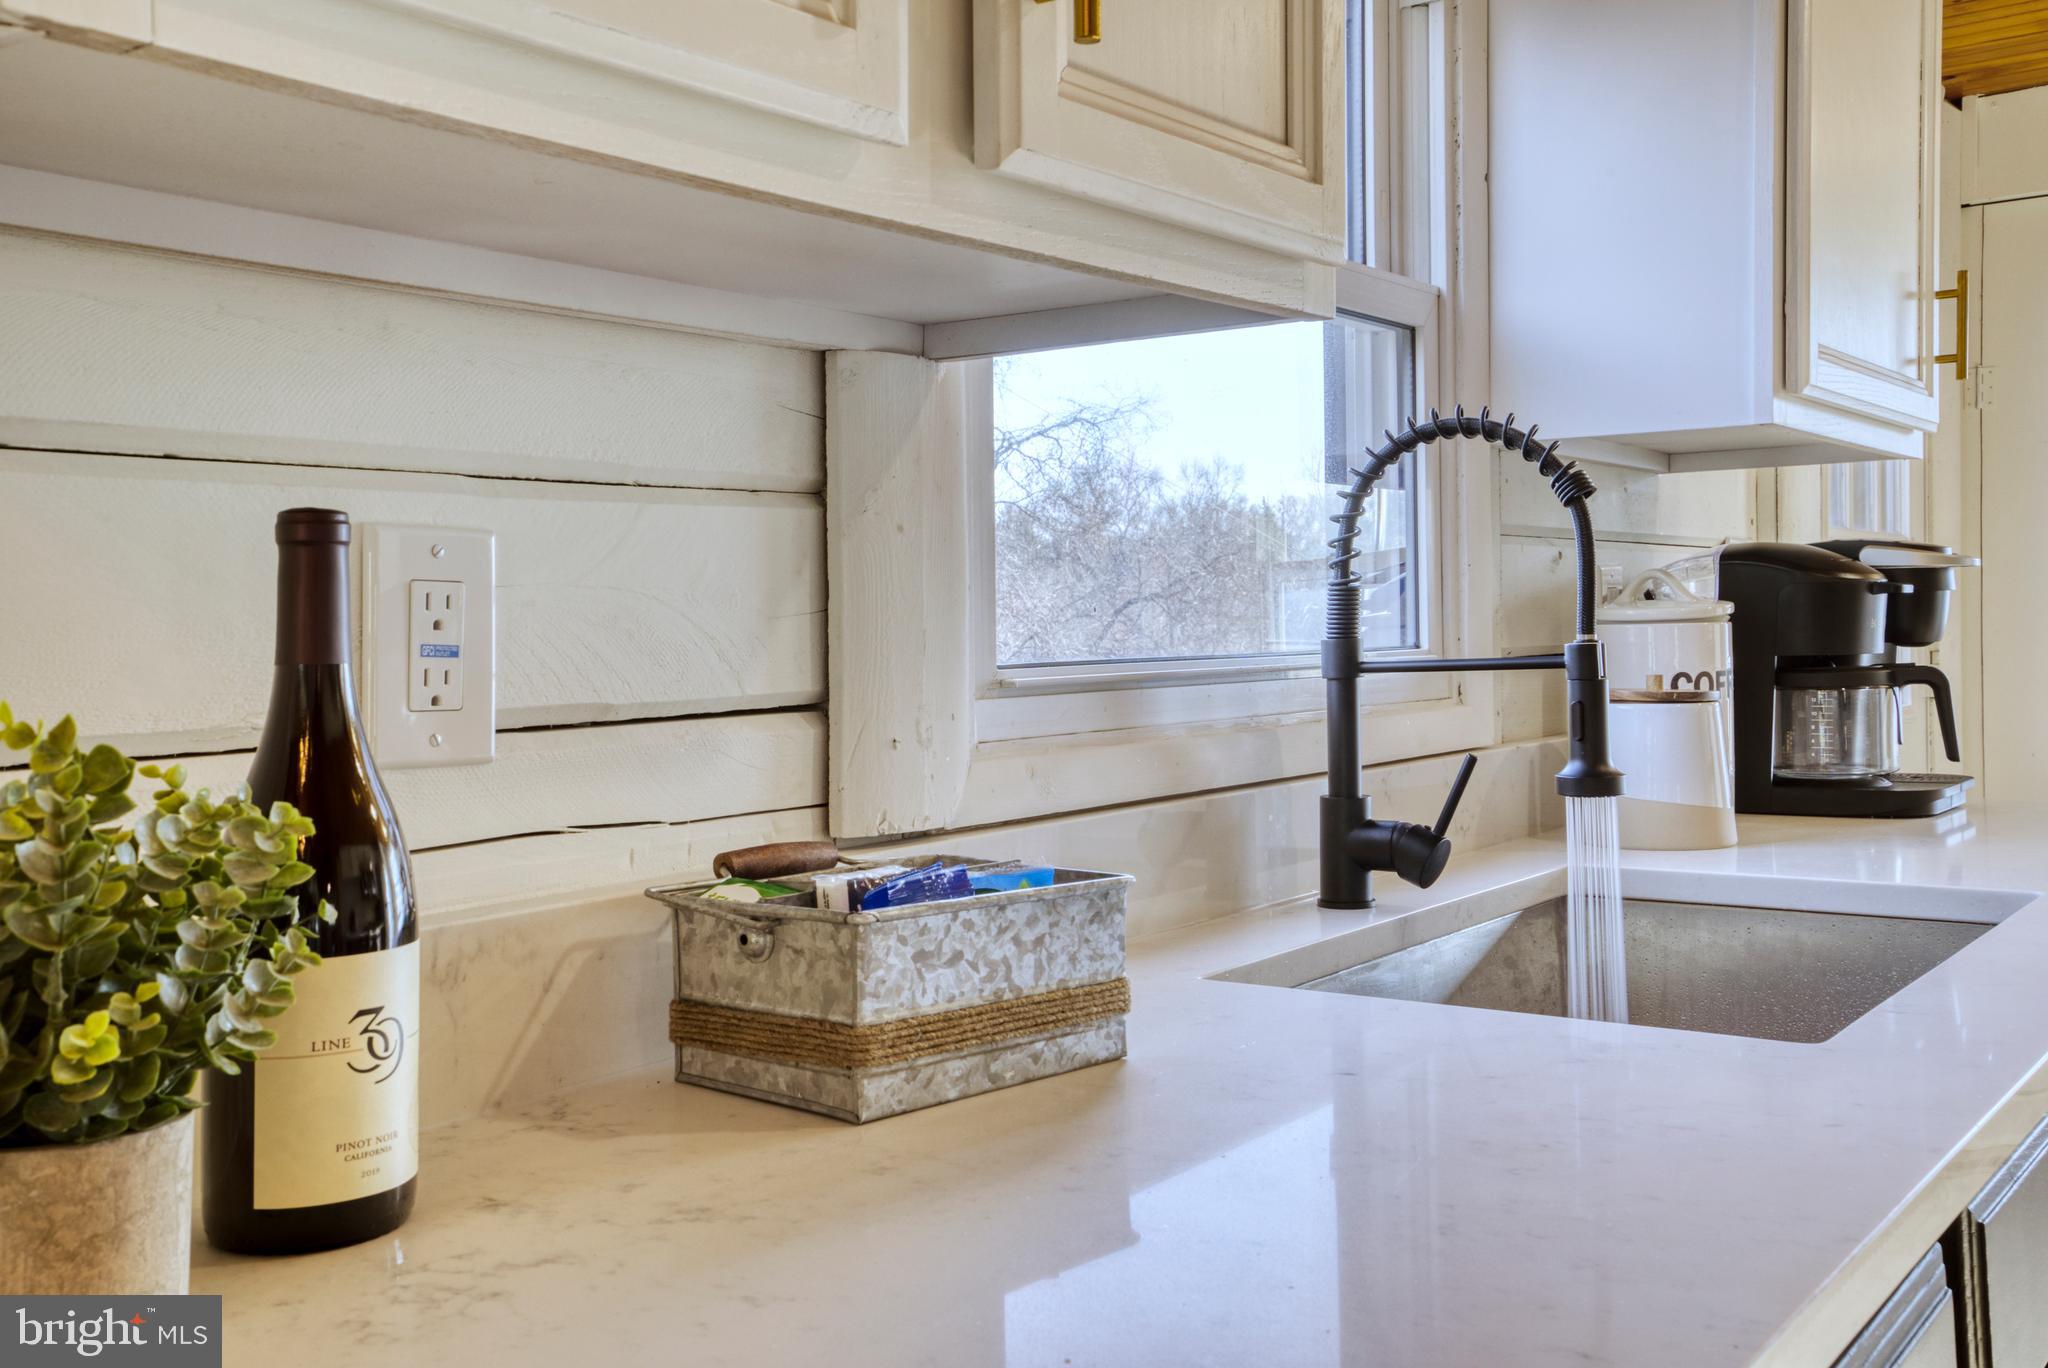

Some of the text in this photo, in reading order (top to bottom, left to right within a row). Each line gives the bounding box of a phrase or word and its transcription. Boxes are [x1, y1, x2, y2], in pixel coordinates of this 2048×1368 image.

[311, 1005, 404, 1084] LINE 39
[335, 1130, 398, 1153] PINOT NOIR
[344, 1146, 392, 1162] CALIFORNIA
